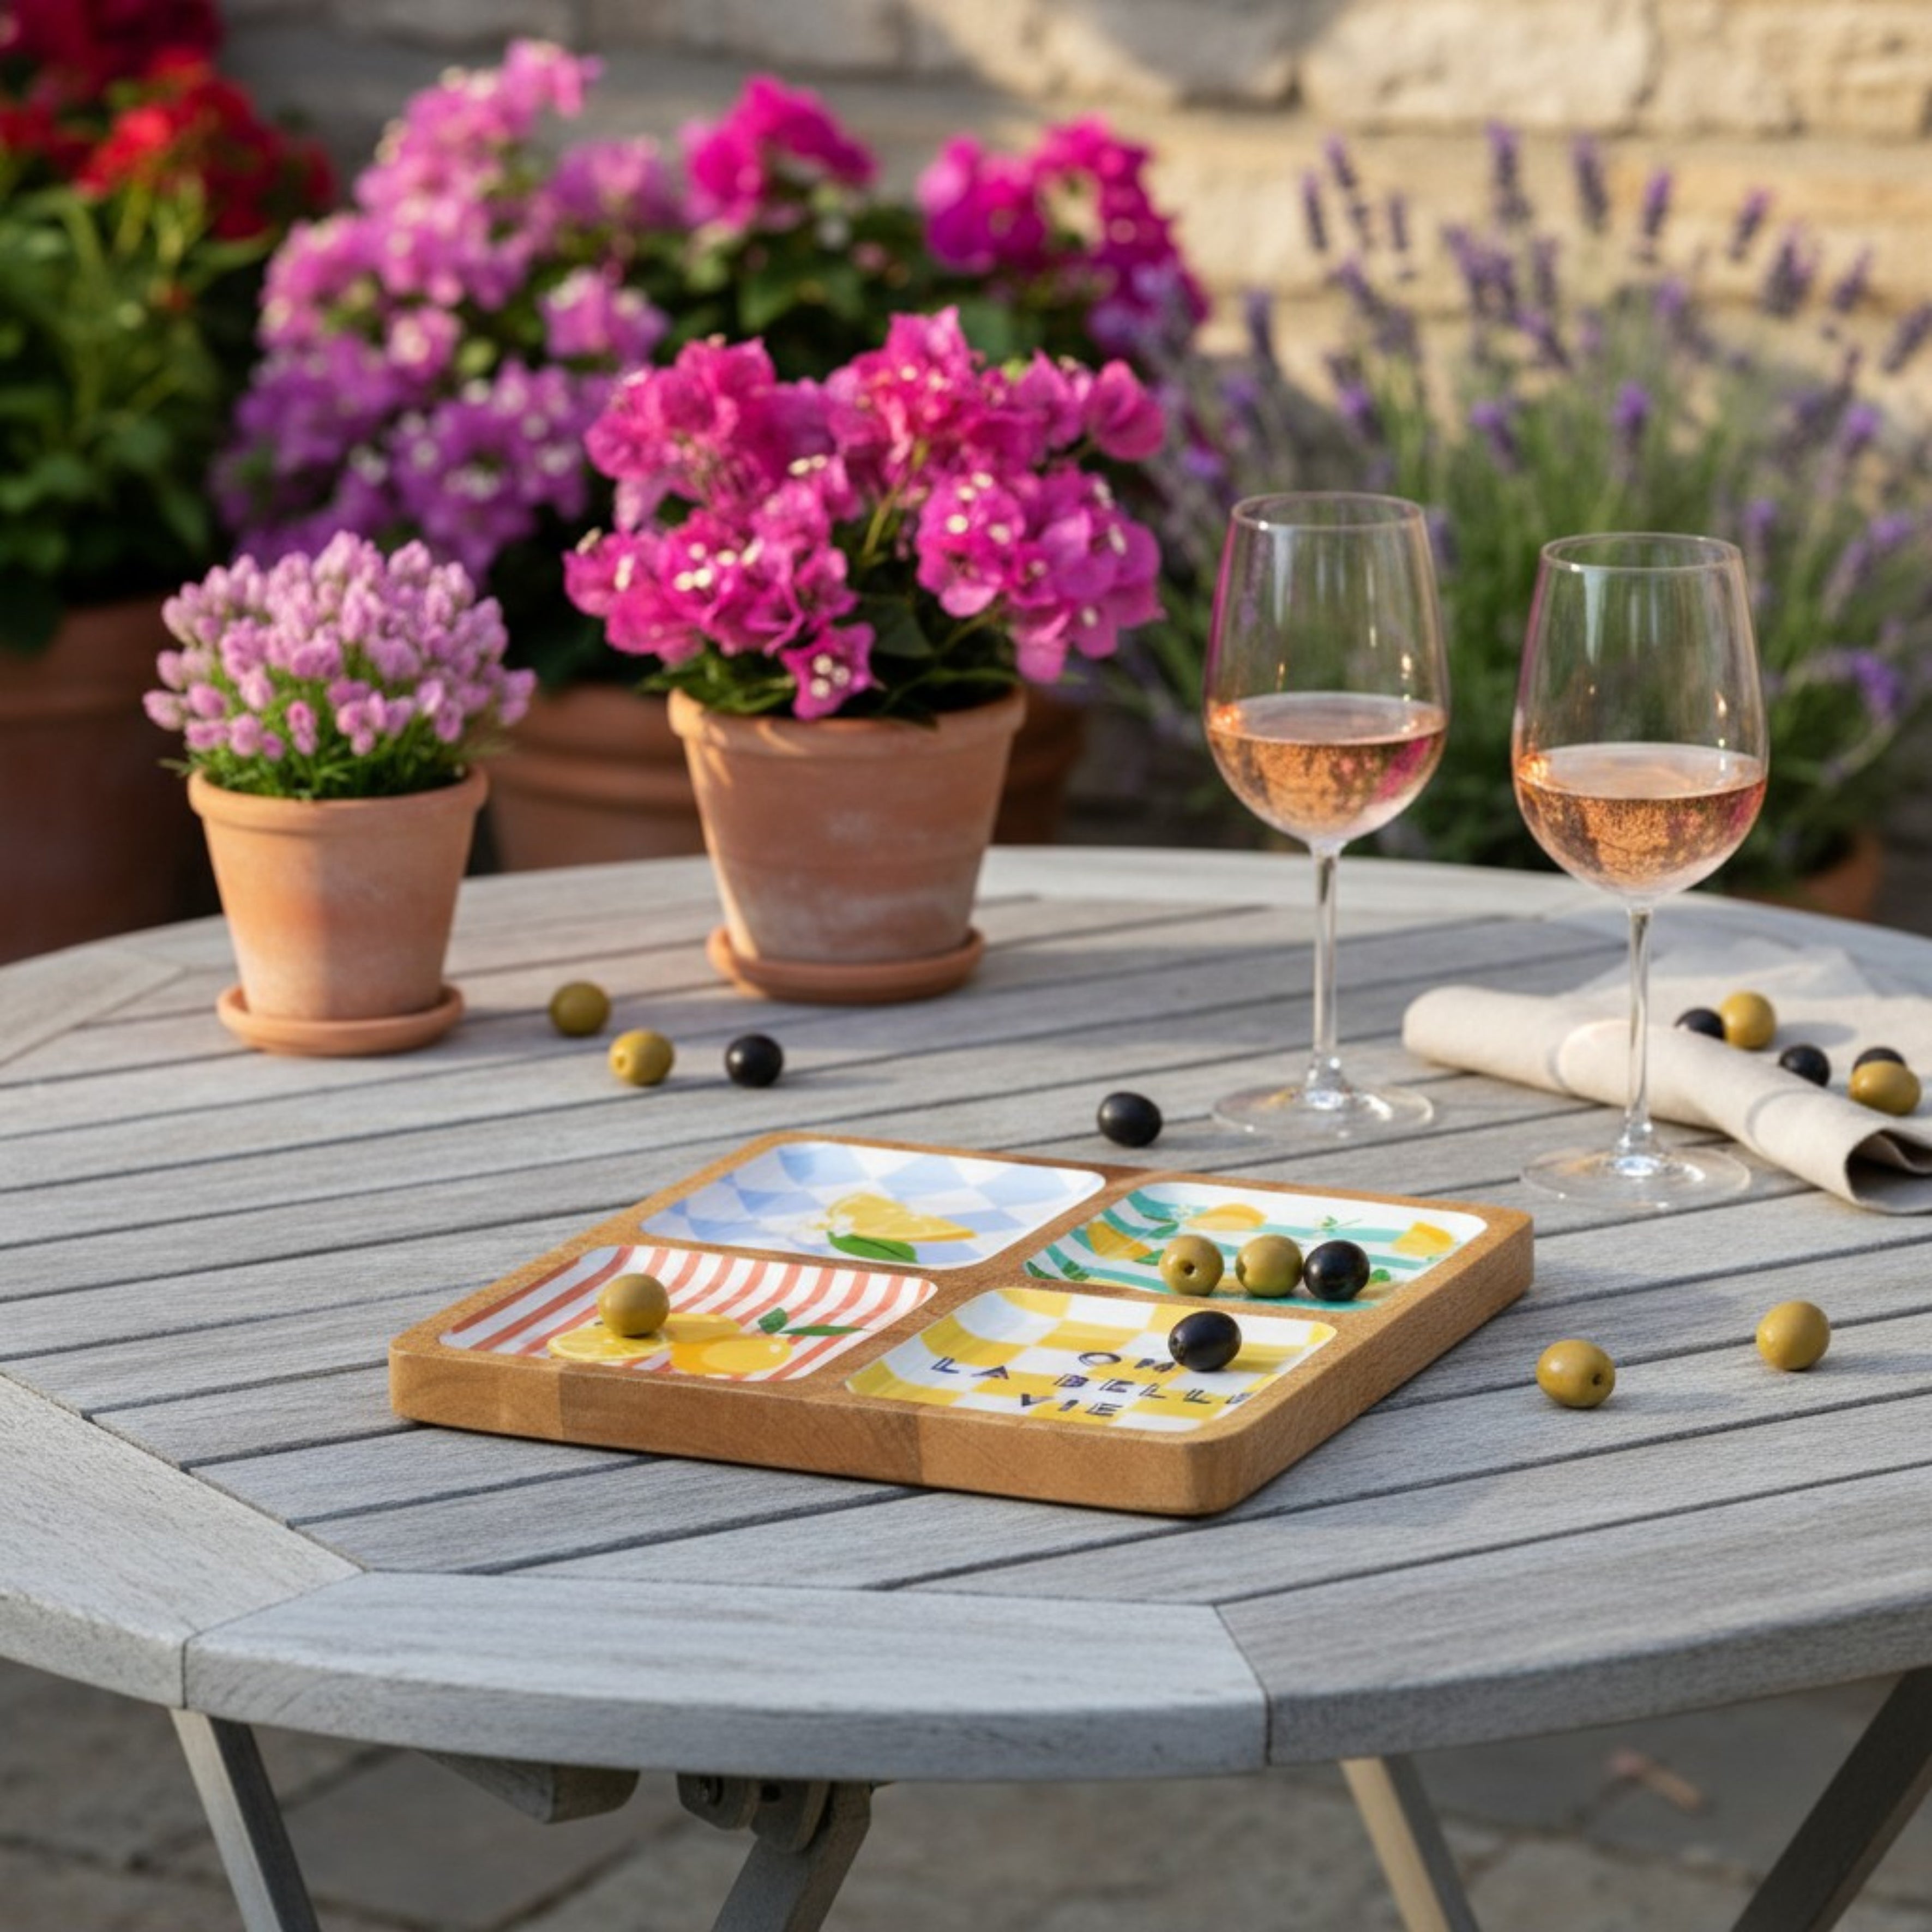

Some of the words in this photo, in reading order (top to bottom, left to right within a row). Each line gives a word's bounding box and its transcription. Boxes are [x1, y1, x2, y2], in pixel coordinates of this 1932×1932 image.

[931, 1356, 1009, 1380] LA
[1053, 1373, 1253, 1404] BELLE
[1021, 1393, 1123, 1417] VIE
